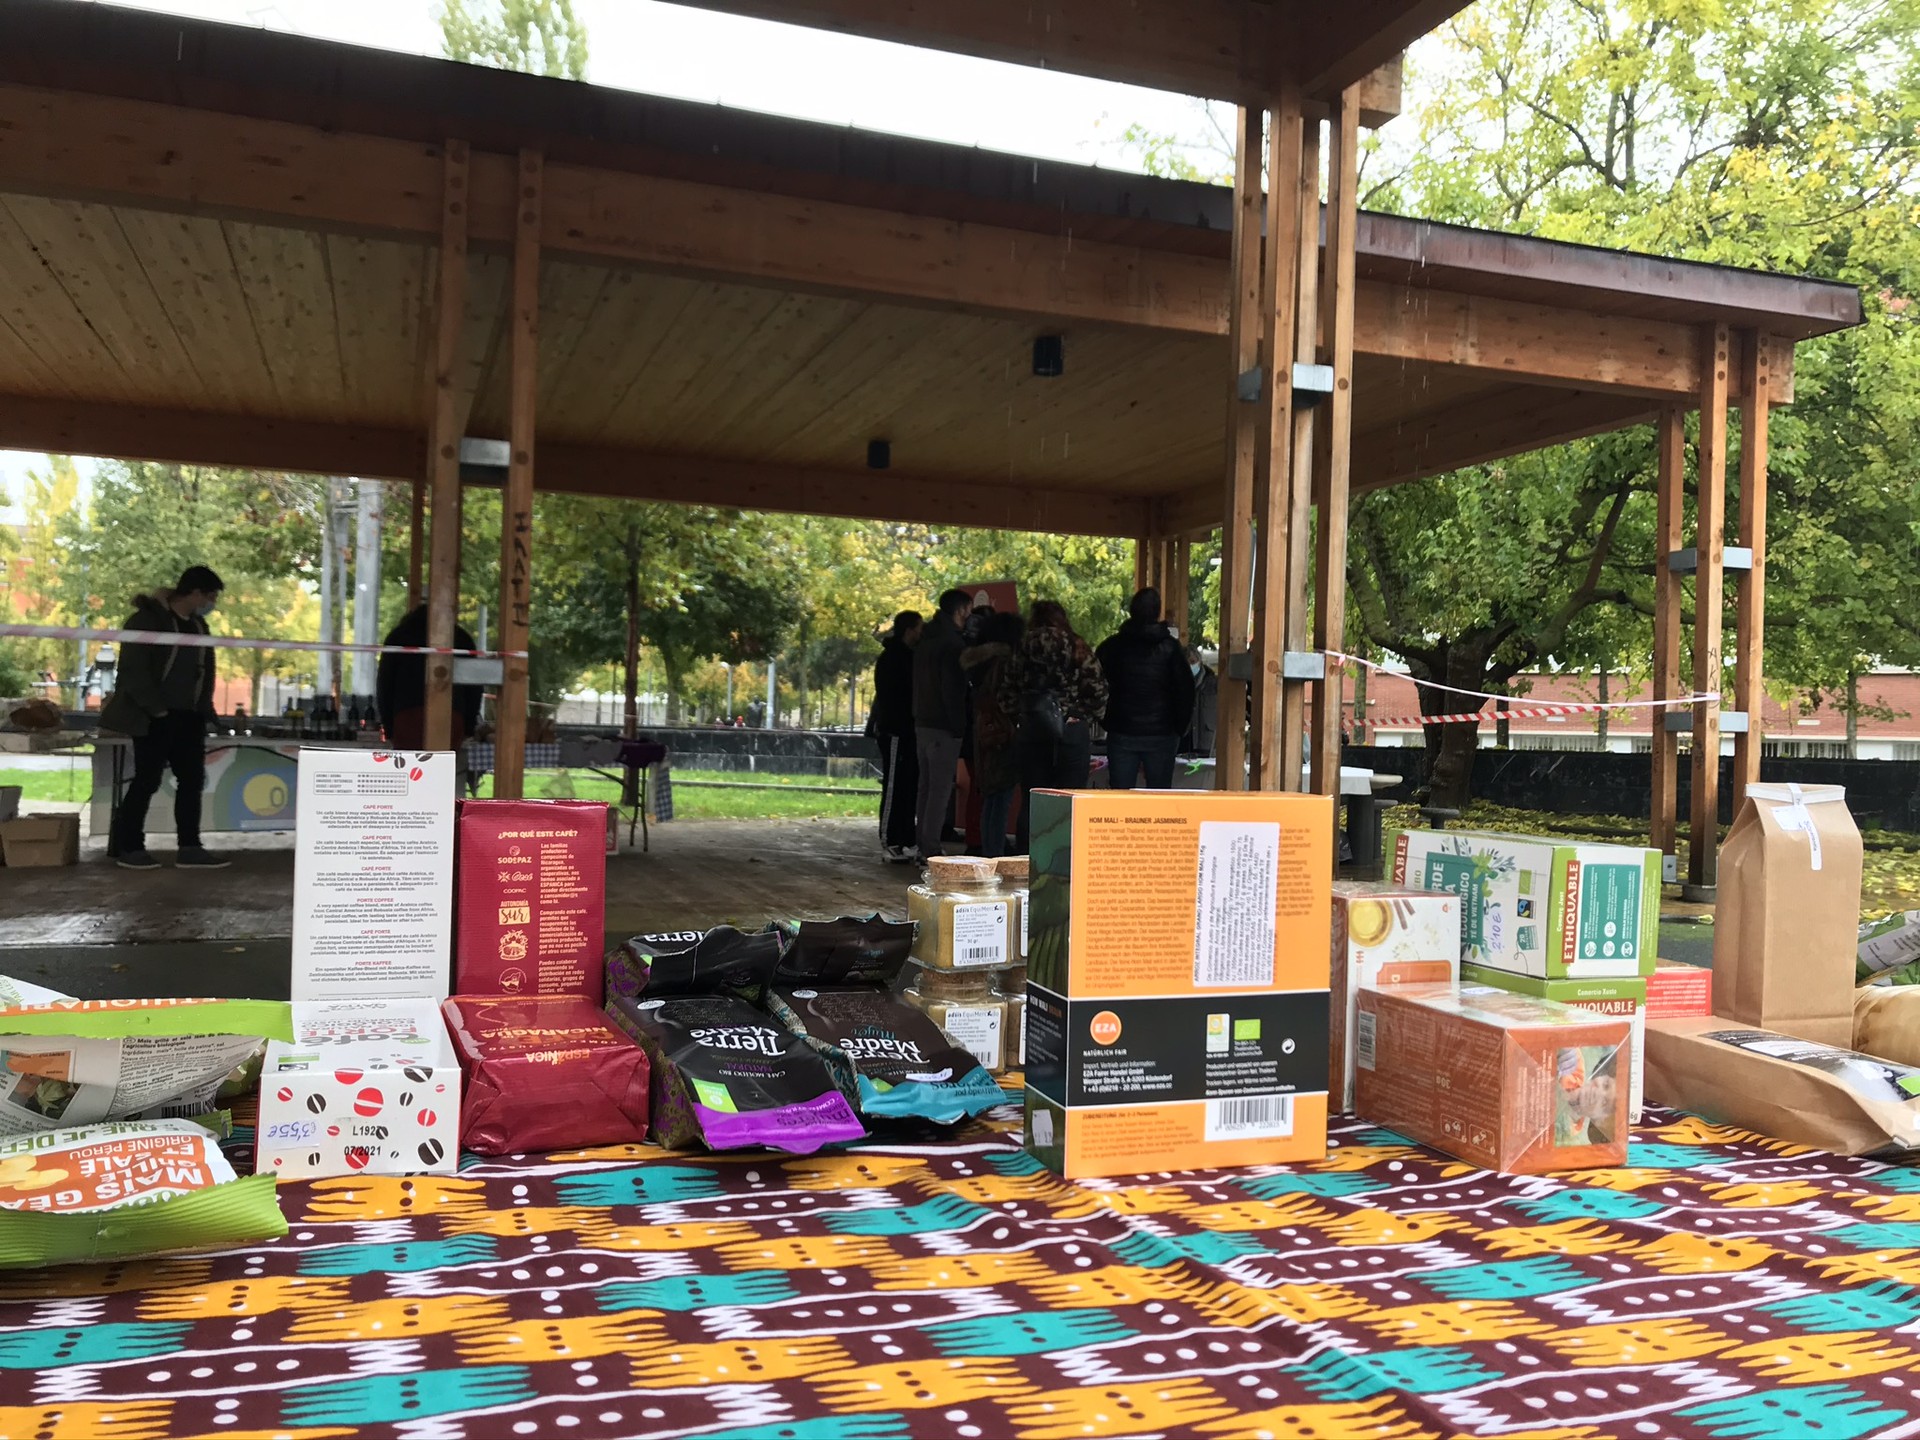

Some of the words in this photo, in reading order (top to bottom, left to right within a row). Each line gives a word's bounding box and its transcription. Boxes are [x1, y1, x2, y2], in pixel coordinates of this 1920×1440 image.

[497, 830, 518, 840] ¿POR
[519, 830, 534, 838] QUÉ
[535, 830, 553, 838] ESTE
[555, 829, 577, 837] CAFÉ?
[501, 908, 528, 923] sur
[1564, 864, 1579, 959] ETHIQUABLE
[1472, 919, 1478, 928] DE
[300, 1026, 417, 1037] FORTE
[1095, 1023, 1116, 1033] EZA
[300, 1033, 418, 1047] café
[696, 1034, 787, 1056] Tierra
[840, 1038, 920, 1053] Madre
[850, 1050, 930, 1064] Tierra
[1083, 1049, 1114, 1057] NATÜRLICH
[1114, 1048, 1127, 1056] FAIR
[726, 1062, 773, 1072] NATURAL
[955, 1089, 966, 1097] por
[127, 1136, 192, 1152] ORIGINE
[162, 1143, 194, 1155] ET
[344, 1146, 381, 1156] 07/2021
[69, 1143, 123, 1160] PÉROU
[79, 1152, 151, 1178] SALÉ
[95, 1167, 204, 1200] MAÏS
